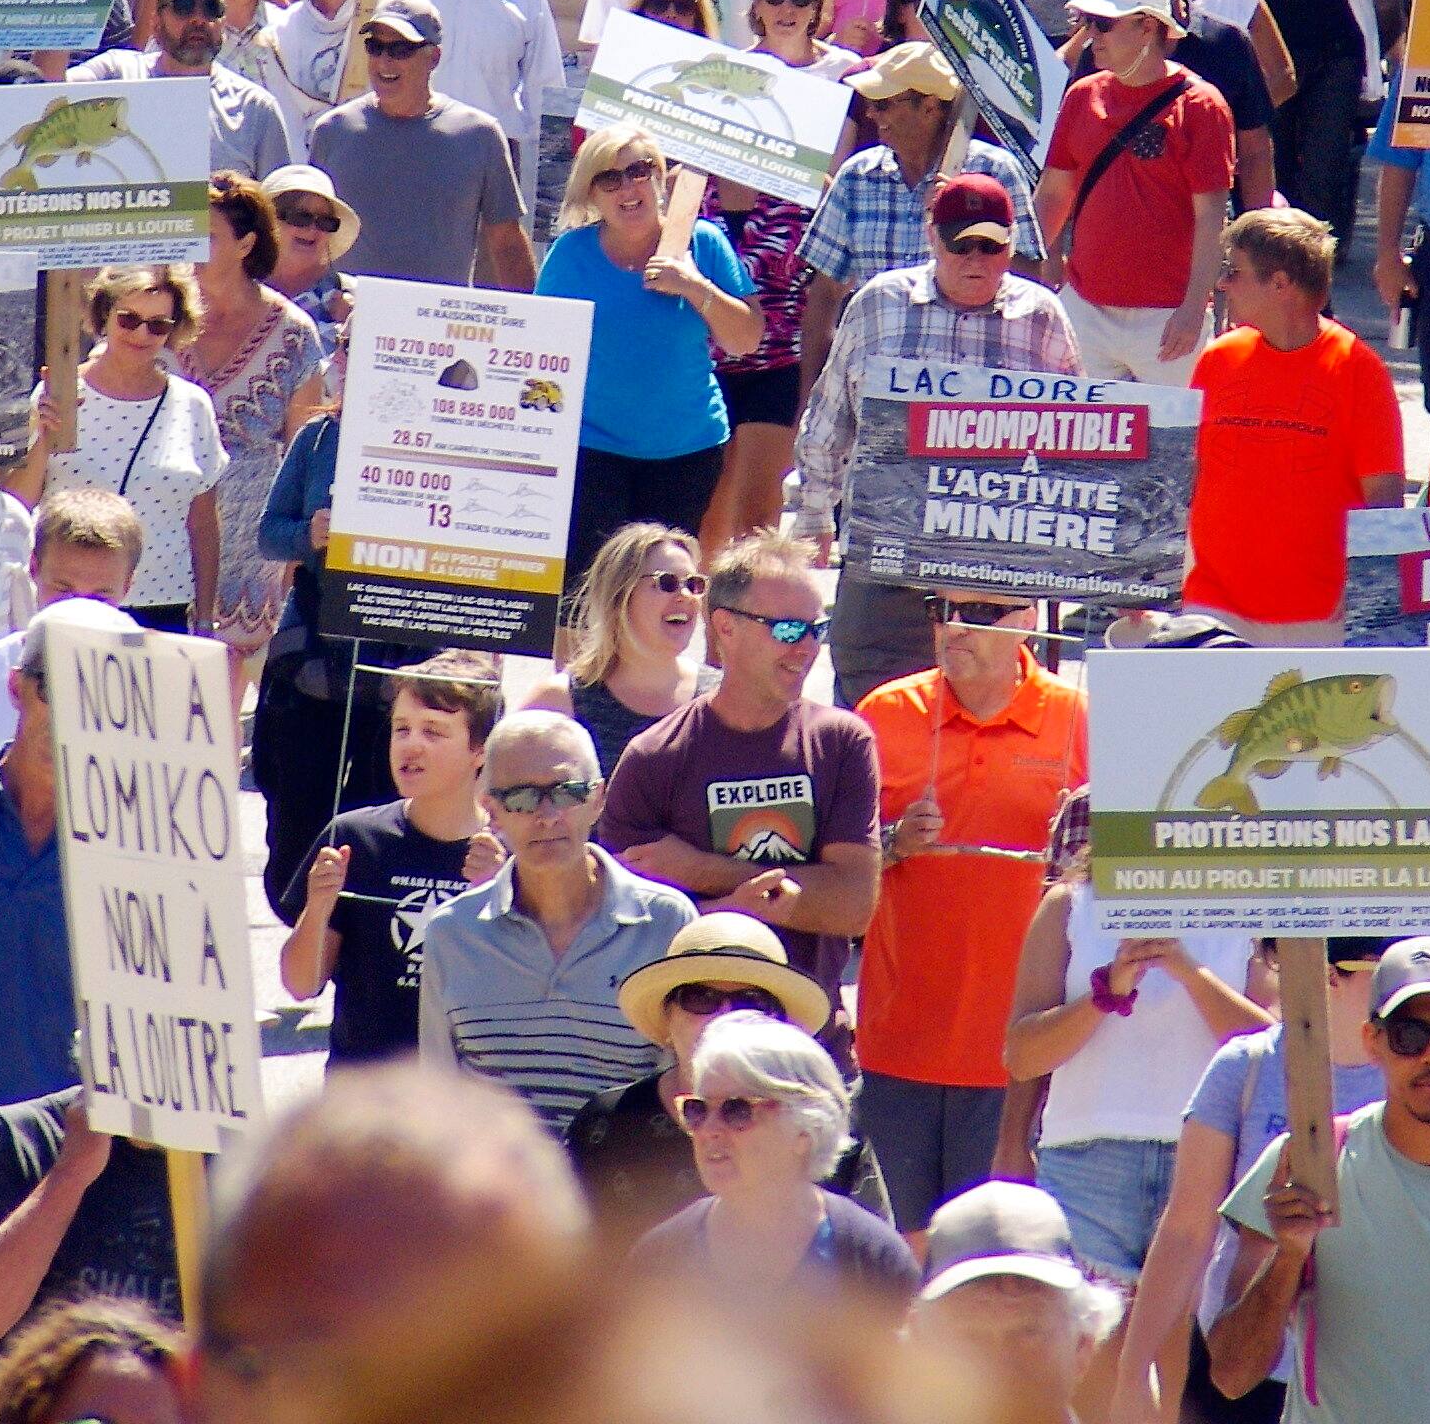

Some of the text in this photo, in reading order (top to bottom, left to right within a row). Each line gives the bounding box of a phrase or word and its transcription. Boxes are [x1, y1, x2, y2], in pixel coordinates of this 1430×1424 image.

[722, 123, 755, 144] NOS
[755, 135, 797, 159] LACS
[85, 192, 123, 211] NOS
[125, 189, 171, 208] LACS
[3, 225, 58, 241] PROJET
[62, 222, 113, 238] MINIER
[116, 222, 136, 235] LA
[137, 219, 194, 234] LOUTRE
[489, 348, 570, 373] 2 250 000
[890, 366, 963, 397] LAC
[925, 409, 1135, 453] INCOMPATIBLE
[1022, 450, 1040, 474] À
[361, 465, 451, 491] 40 100 000
[927, 465, 1121, 512] L'ACTIVITÉ
[428, 503, 452, 528] 13
[922, 499, 1117, 553] MINIÈRE
[352, 541, 426, 572] NON
[919, 560, 1169, 599] protectionpetitenation.com
[74, 647, 215, 746] NON À
[61, 743, 231, 862] LOMIKO
[714, 779, 806, 806] EXPLORE
[1156, 814, 1331, 849] PROTÉGEONS
[1335, 819, 1393, 847] NOS
[1115, 869, 1168, 890] NON
[1170, 869, 1202, 889] AU
[1210, 869, 1295, 889] PROJET
[1299, 868, 1375, 888] MINIER
[1382, 867, 1414, 887] LA
[1107, 908, 1127, 917] LAC
[101, 881, 228, 992] NON À
[82, 998, 248, 1120] LA LOUTRE
